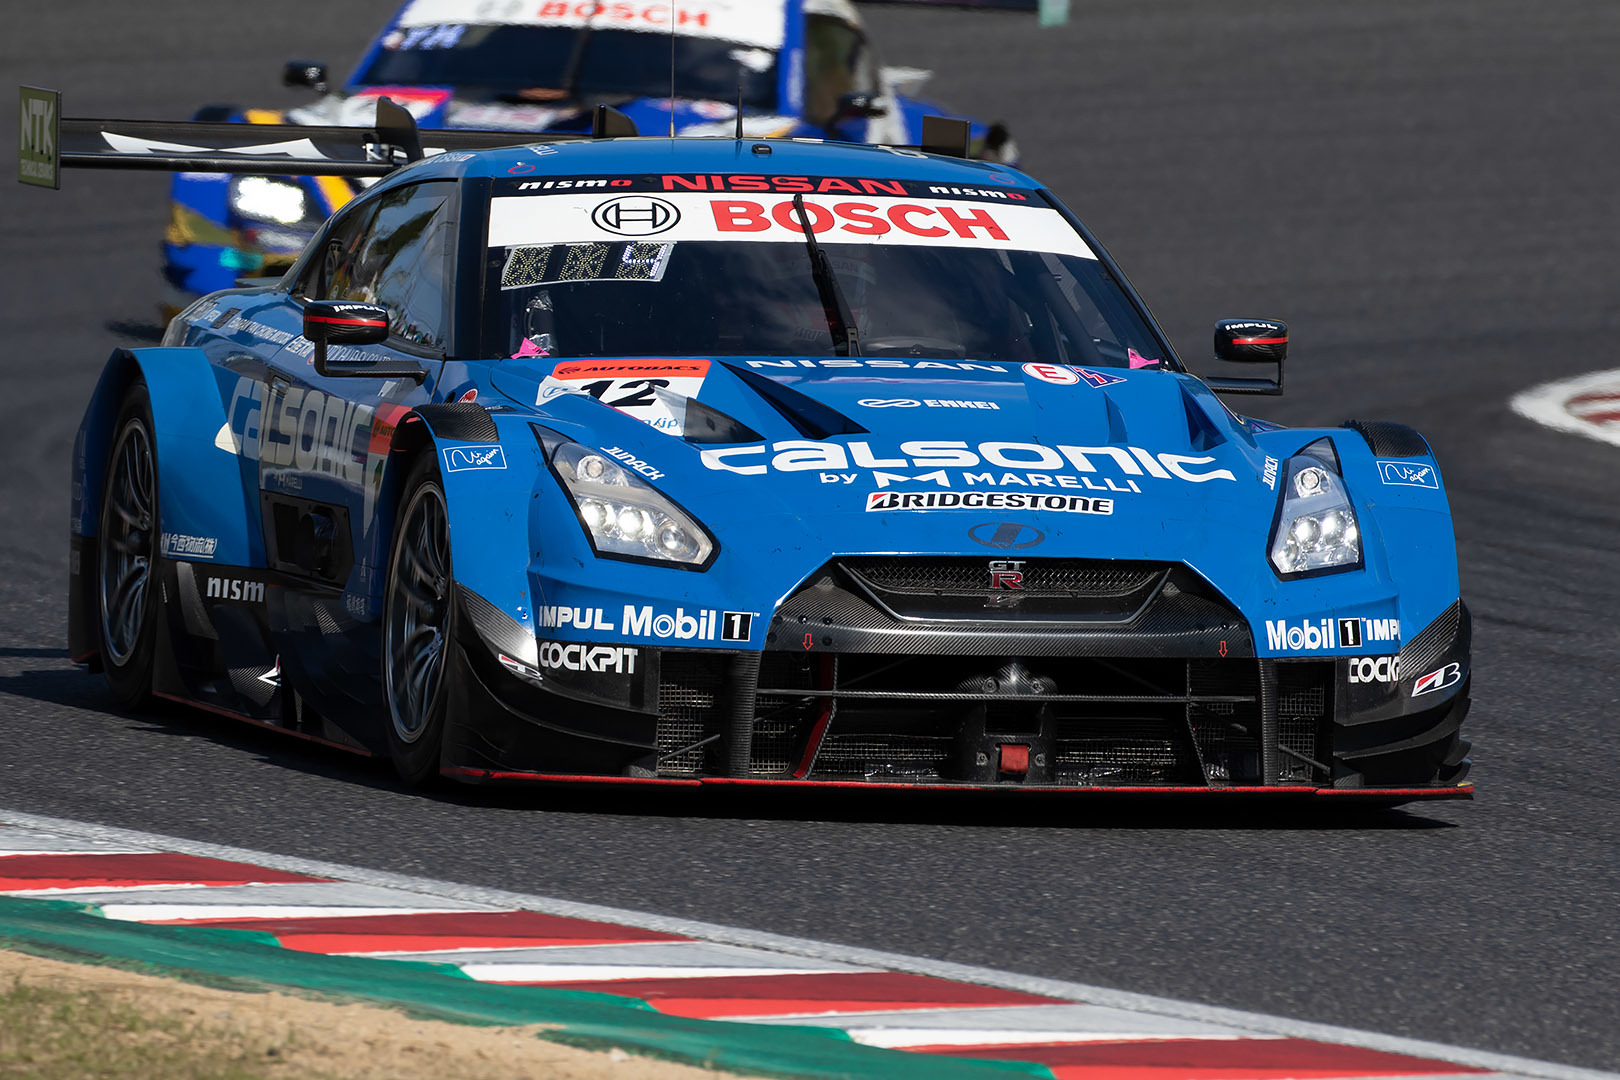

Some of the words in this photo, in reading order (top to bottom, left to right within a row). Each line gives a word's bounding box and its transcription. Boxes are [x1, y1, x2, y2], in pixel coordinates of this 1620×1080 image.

[538, 1, 709, 27] BOSCH
[20, 98, 54, 156] NTK
[518, 179, 632, 190] nismo
[661, 175, 909, 195] NISSAN
[929, 186, 1027, 201] nismo
[709, 200, 1010, 241] BOSCH
[333, 305, 386, 313] IMPUL
[1225, 323, 1278, 331] IMPUL
[745, 359, 1009, 373] NISSAN
[582, 379, 670, 407] 12
[922, 399, 1001, 410] ENKEI
[600, 446, 665, 480] JUNACK
[1262, 455, 1279, 491] JUNACK
[819, 471, 858, 485] by
[962, 472, 1142, 494] MARELLI
[868, 492, 1112, 514] BRIDGESTONE
[988, 560, 1027, 571] GT
[989, 571, 1025, 590] R
[538, 606, 615, 631] IMPUL
[621, 605, 717, 641] Mobil
[1265, 618, 1335, 650] Mobil
[538, 641, 639, 675] COCKPIT
